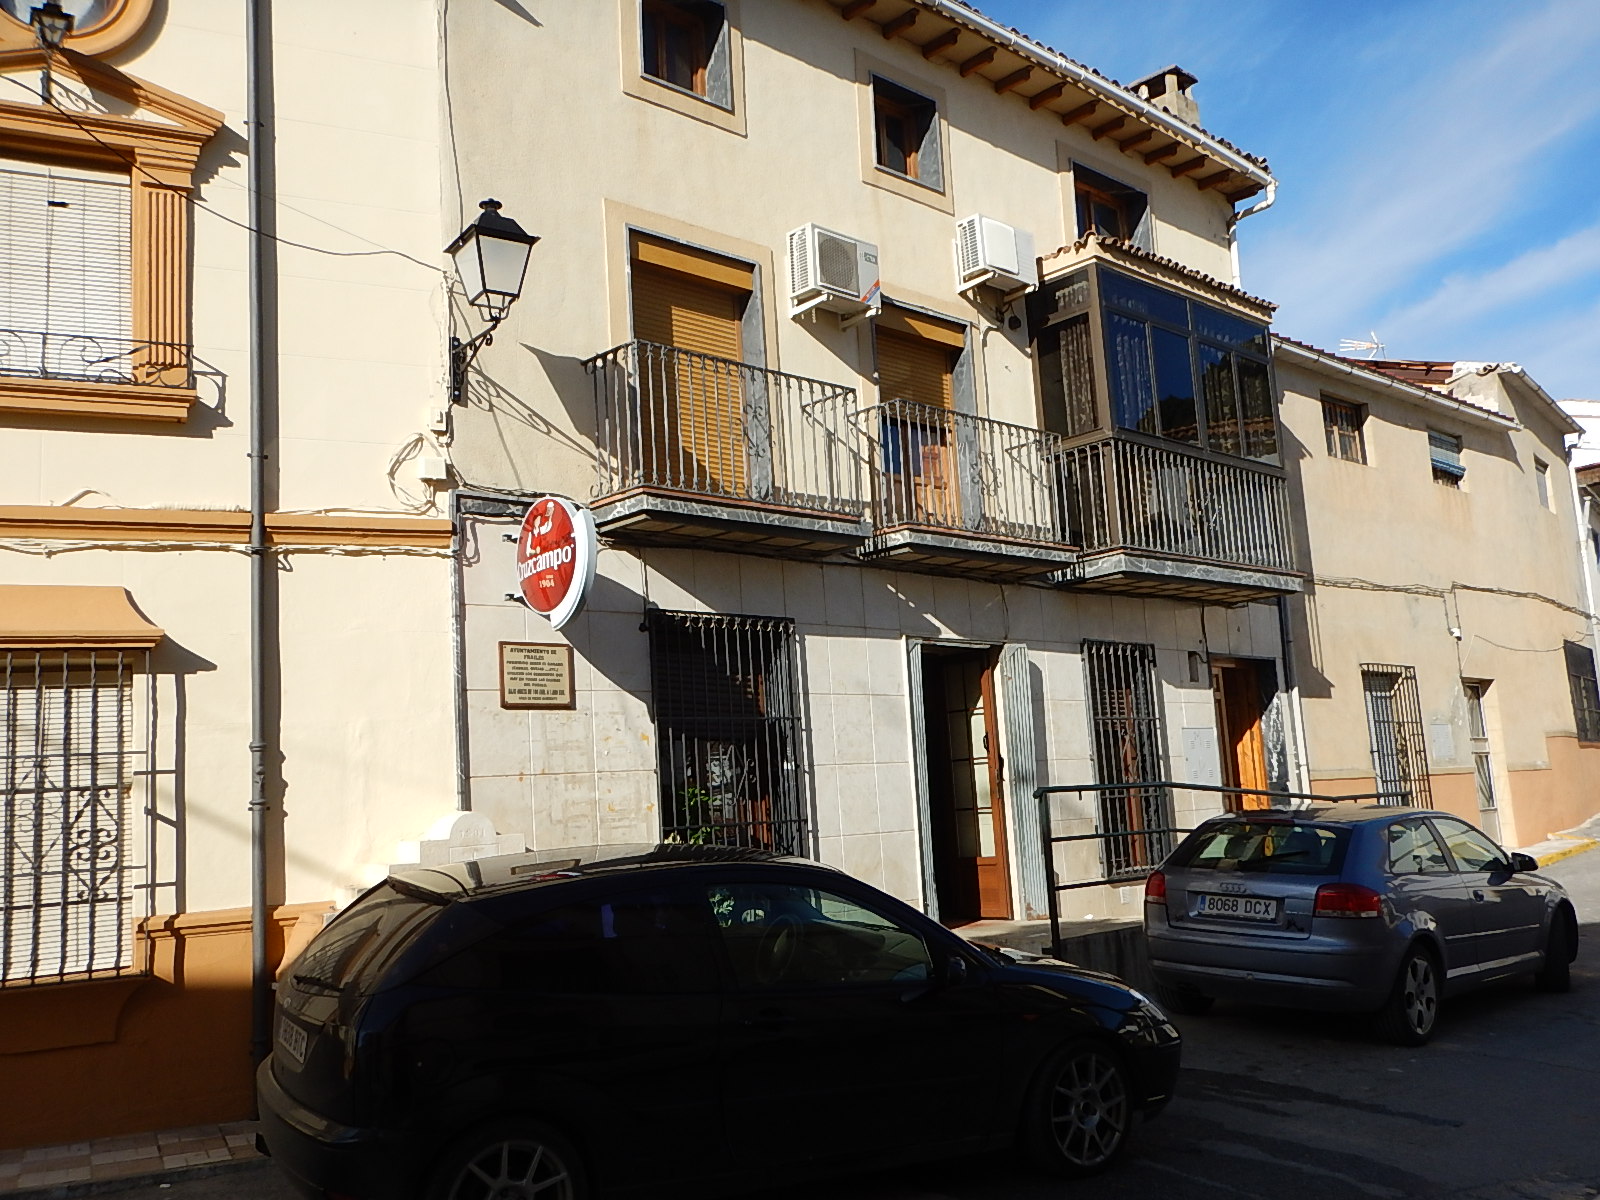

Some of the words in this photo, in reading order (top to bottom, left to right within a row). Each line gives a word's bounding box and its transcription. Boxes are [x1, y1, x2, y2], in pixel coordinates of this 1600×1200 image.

[539, 579, 555, 589] 1904
[1208, 897, 1239, 912] 8068
[1244, 900, 1271, 916] DCX
